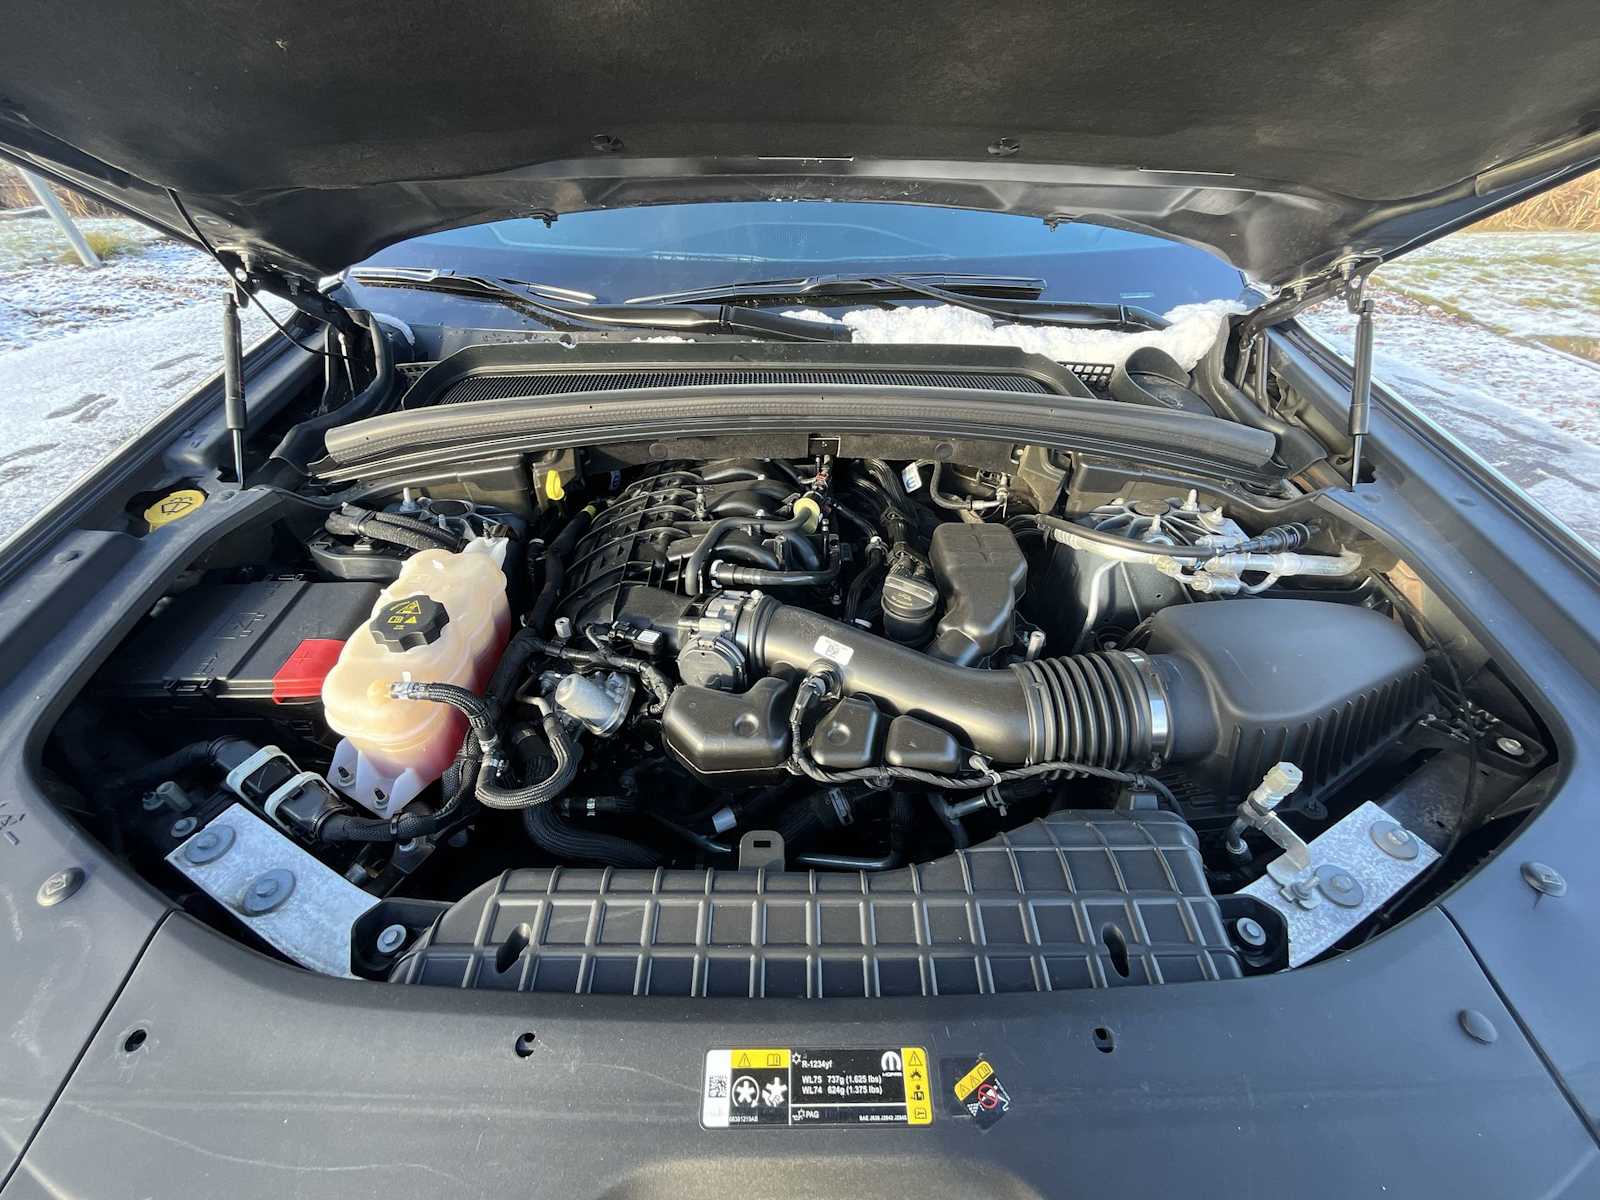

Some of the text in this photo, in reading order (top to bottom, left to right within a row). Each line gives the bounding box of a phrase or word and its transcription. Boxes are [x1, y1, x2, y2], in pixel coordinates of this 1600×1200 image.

[801, 1060, 832, 1070] R-1234yf
[802, 1075, 822, 1084] WL75
[827, 1075, 845, 1085] 737g
[868, 1075, 882, 1084] lbs)
[802, 1086, 822, 1094] WL74
[846, 1085, 867, 1095] (1.375
[868, 1085, 883, 1095] lbs)
[805, 1110, 819, 1119] PAG
